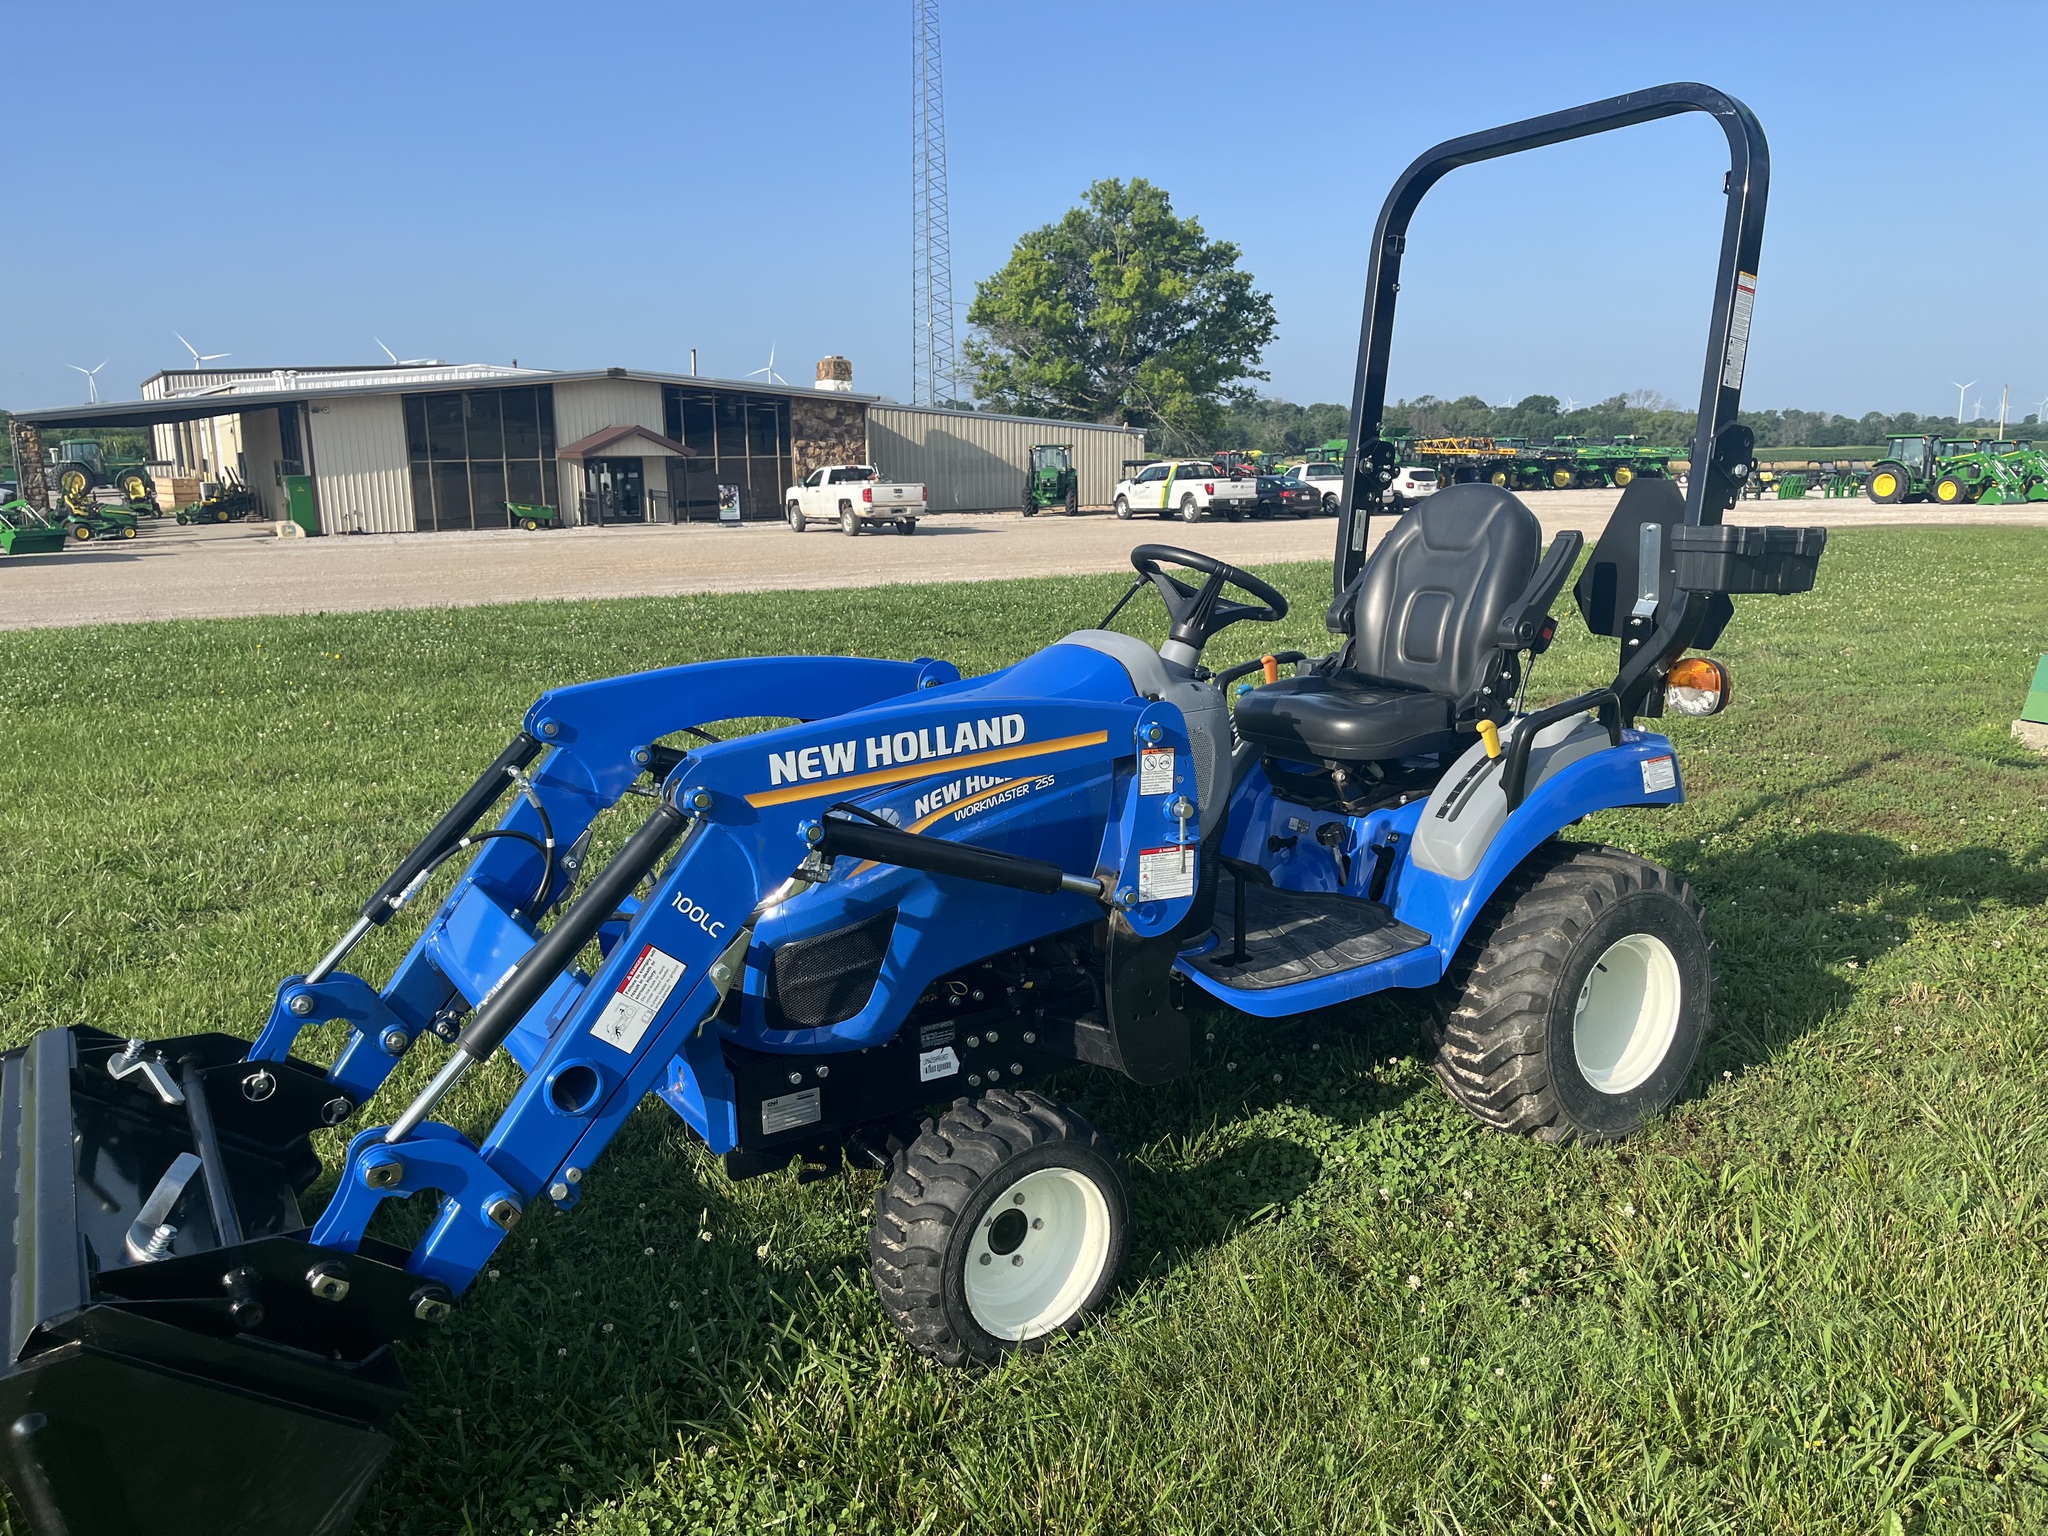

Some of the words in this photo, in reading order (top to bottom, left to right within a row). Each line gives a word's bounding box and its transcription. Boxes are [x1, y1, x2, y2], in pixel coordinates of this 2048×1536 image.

[768, 740, 857, 786] NEW
[866, 713, 1026, 768] HOLLAND
[914, 780, 961, 819] NEW
[954, 784, 1030, 821] WORKMASTER
[1035, 774, 1055, 791] 25S
[671, 890, 725, 939] 100LC
[629, 956, 643, 975] DANGER
